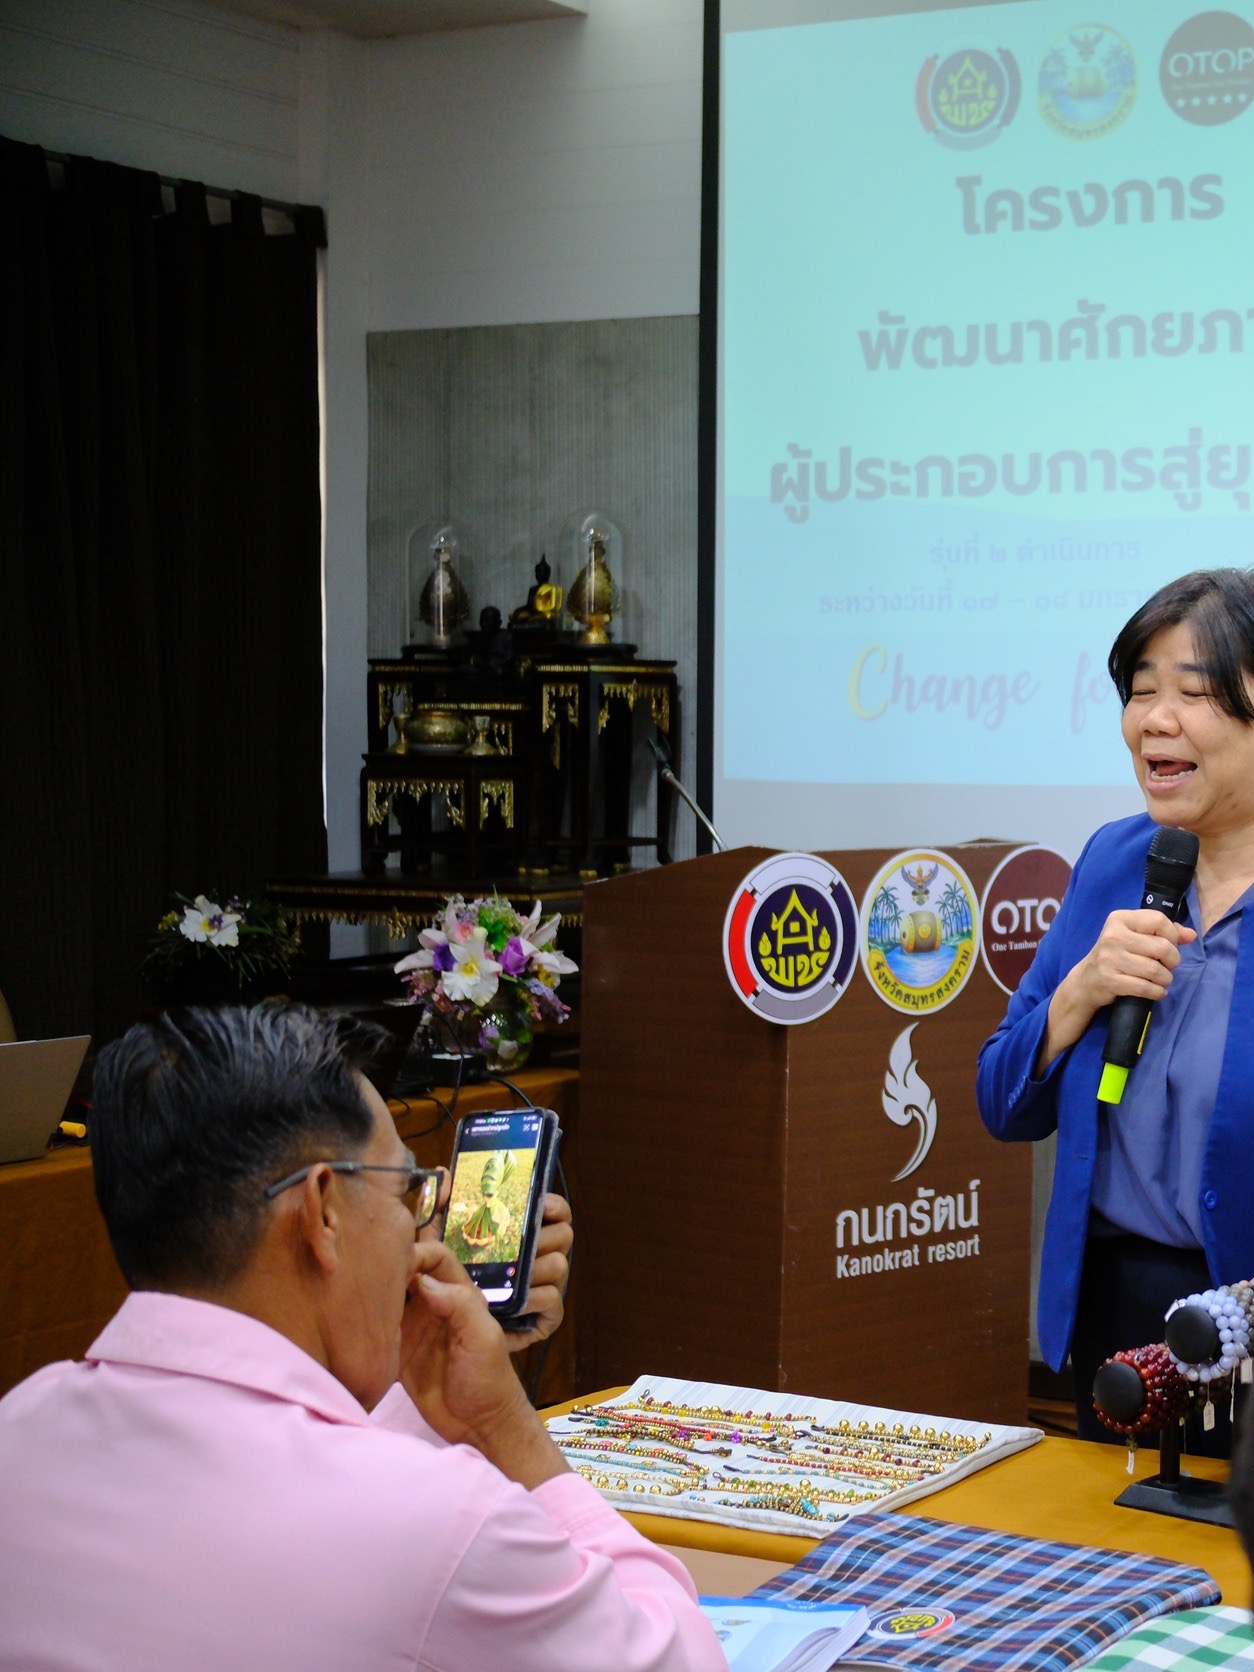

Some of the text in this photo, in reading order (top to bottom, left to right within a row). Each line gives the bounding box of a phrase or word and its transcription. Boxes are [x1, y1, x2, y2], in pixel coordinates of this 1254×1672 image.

[955, 173, 1226, 236] โครงการ
[1077, 588, 1149, 610] มกรา
[847, 643, 1041, 732] Change
[991, 897, 1064, 935] OTO
[991, 940, 1037, 952] One Tambon
[835, 1178, 981, 1249] กนกรัตน์
[836, 1233, 981, 1279] Kanokrat resort
